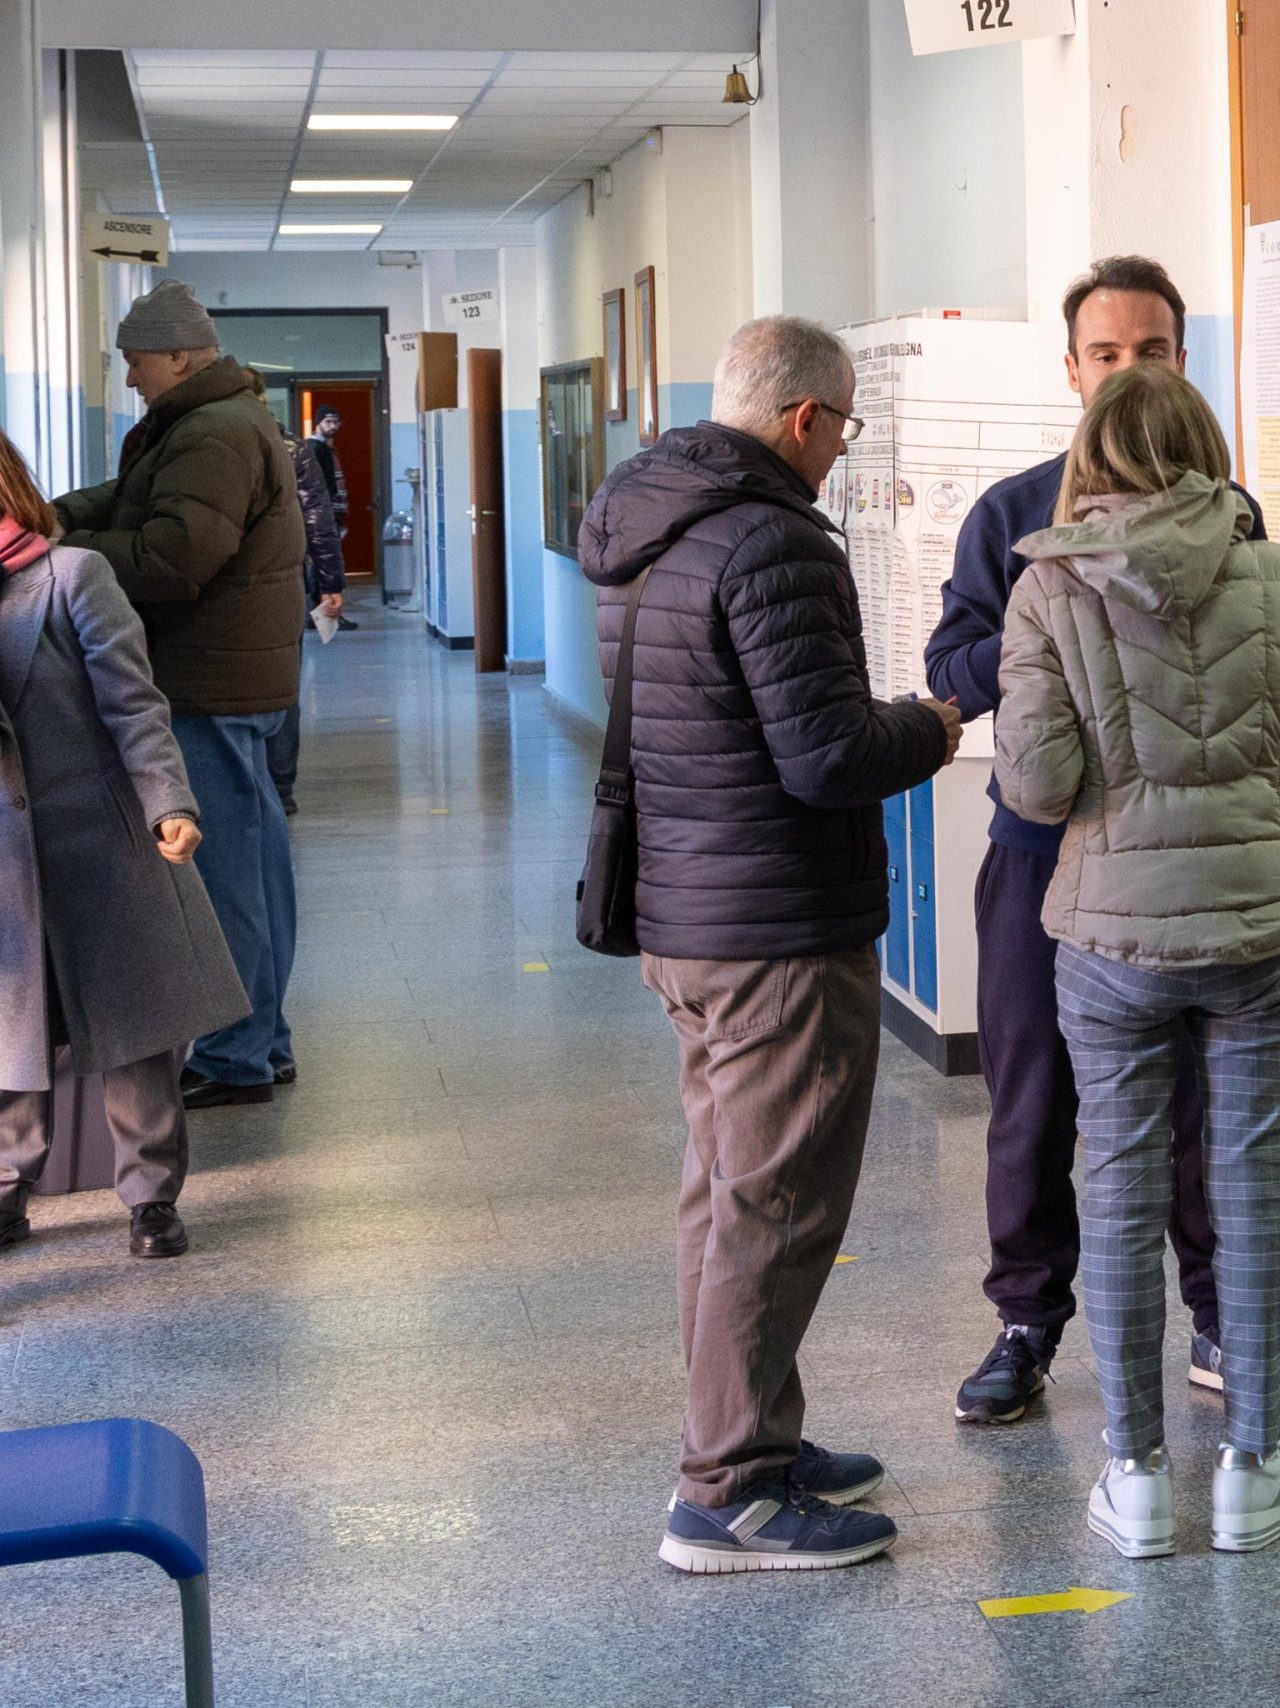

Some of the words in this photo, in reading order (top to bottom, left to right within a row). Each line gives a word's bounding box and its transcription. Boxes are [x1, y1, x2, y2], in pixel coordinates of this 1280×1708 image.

[961, 0, 1013, 31] 122
[104, 220, 153, 235] ASCENSORE
[461, 291, 493, 303] SEZIONE
[462, 306, 481, 319] 123
[401, 343, 416, 352] 124
